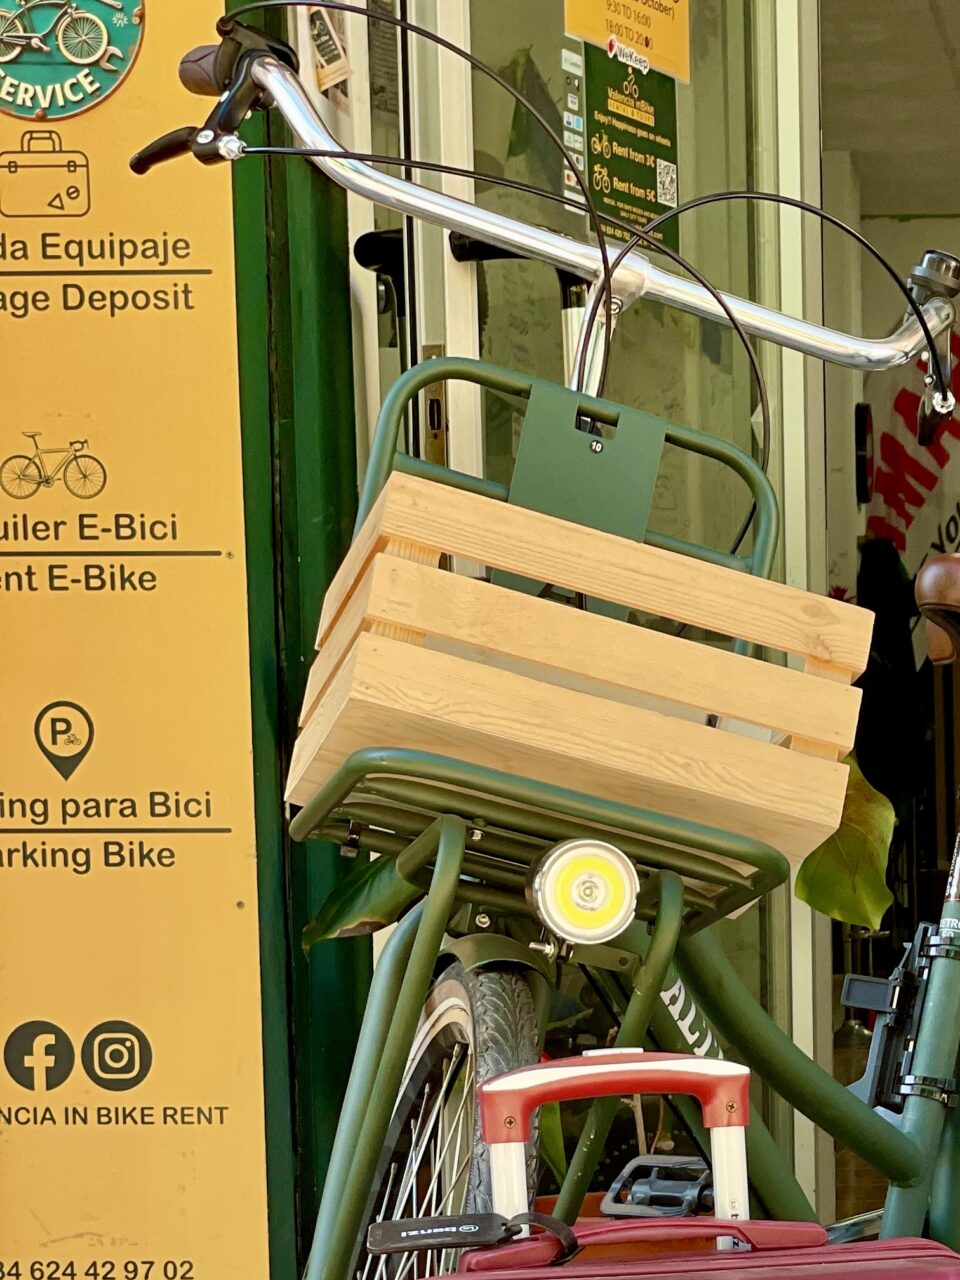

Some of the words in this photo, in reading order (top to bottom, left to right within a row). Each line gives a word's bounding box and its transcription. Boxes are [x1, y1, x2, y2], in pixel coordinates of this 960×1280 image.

[622, 5, 632, 20] TO
[624, 26, 634, 42] TO
[617, 45, 649, 70] WeKeep
[0, 67, 101, 110] ERVICE
[612, 141, 629, 159] Rent
[629, 147, 645, 165] from
[612, 176, 629, 194] Rent
[630, 181, 645, 199] from
[40, 231, 191, 267] Equipaje
[62, 282, 195, 318] Deposit
[590, 440, 603, 453] 10
[78, 513, 178, 542] E-Bici
[0, 563, 39, 592] nt
[48, 562, 158, 592] E-Bike
[50, 717, 73, 746] P
[61, 796, 138, 826] para
[149, 790, 212, 819] Bici
[0, 840, 92, 876] rking
[103, 840, 177, 869] Bike
[64, 1105, 89, 1126] IN
[96, 1105, 156, 1126] BIKE
[162, 1105, 229, 1125] RENT
[29, 1260, 78, 1280] 624
[84, 1260, 117, 1280] 42
[123, 1260, 155, 1280] 97
[162, 1260, 195, 1280] 02
